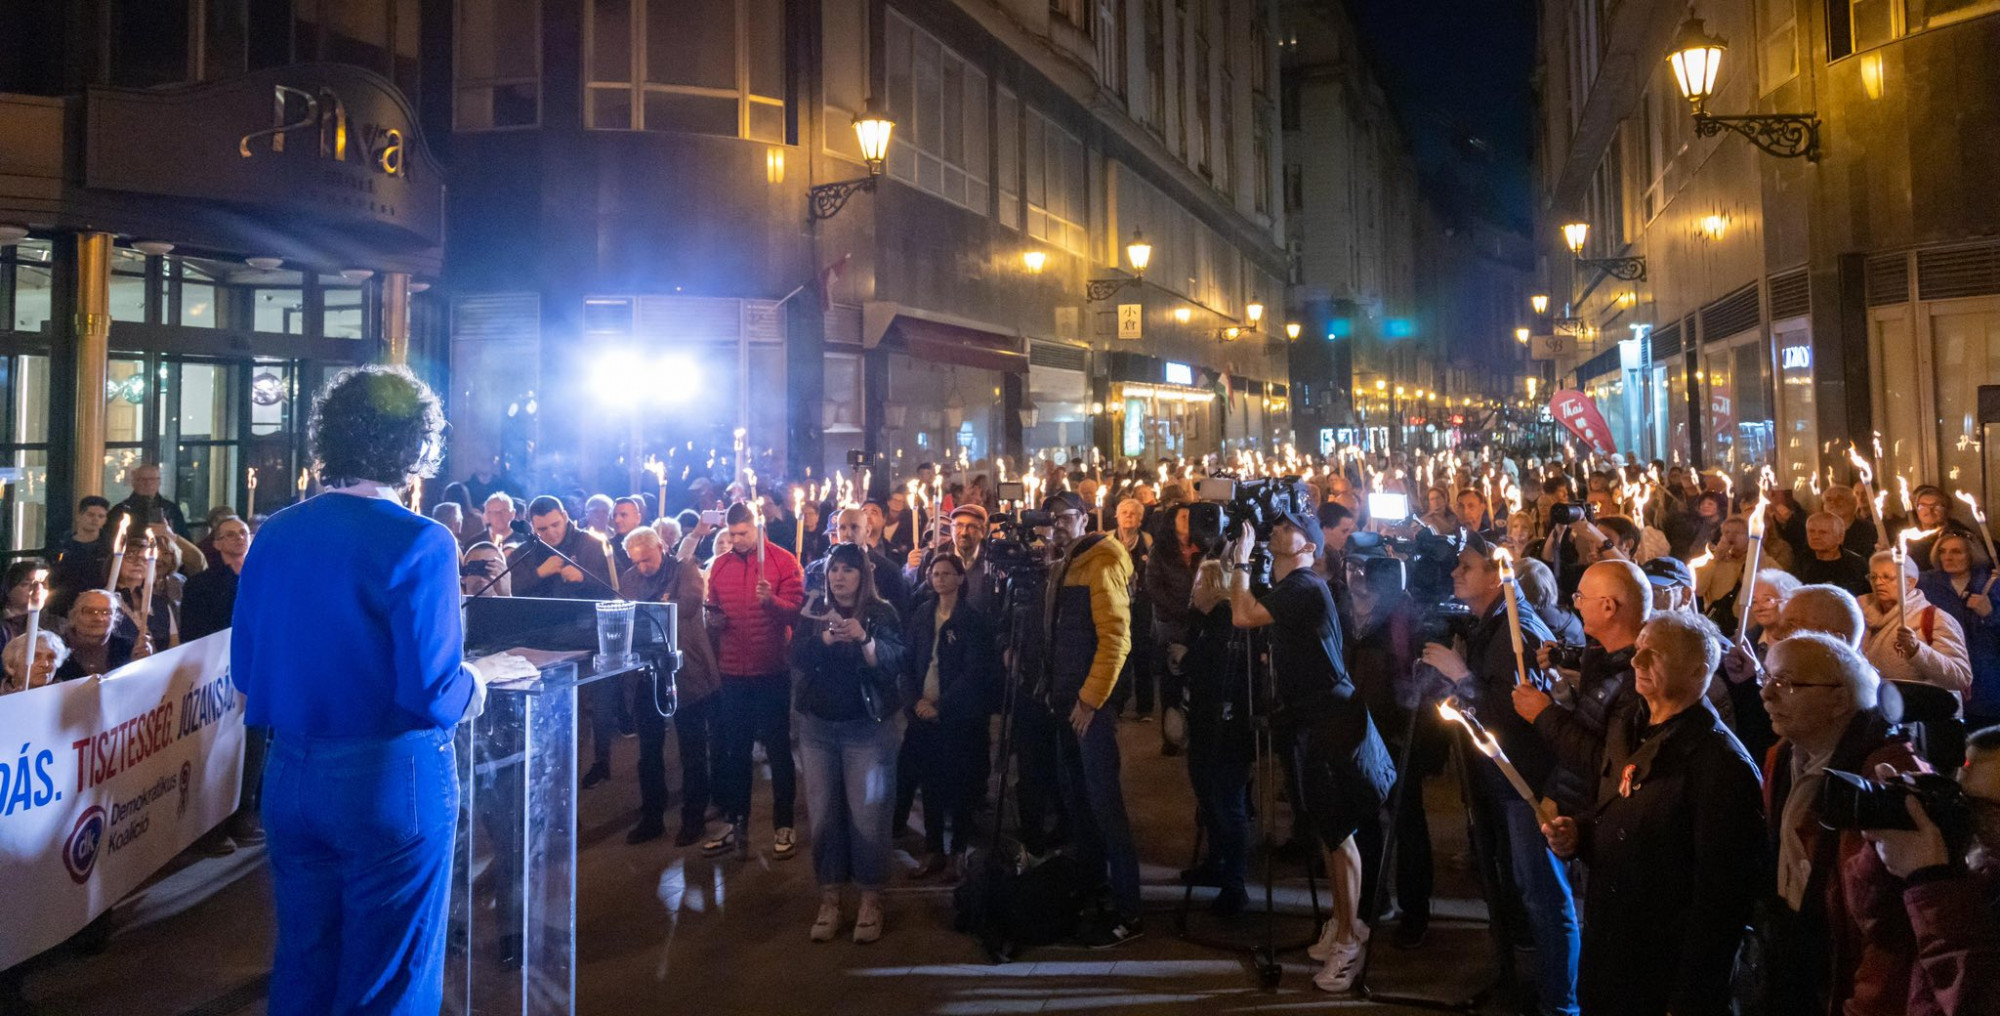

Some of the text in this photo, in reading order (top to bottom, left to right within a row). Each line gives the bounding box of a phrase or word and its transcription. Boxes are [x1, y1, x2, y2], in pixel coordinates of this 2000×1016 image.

[1559, 398, 1584, 419] Thai
[73, 696, 173, 793] TISZTESSÉG.
[111, 773, 177, 826] Demokratikus
[78, 830, 98, 858] dk
[108, 811, 150, 856] Koalició
